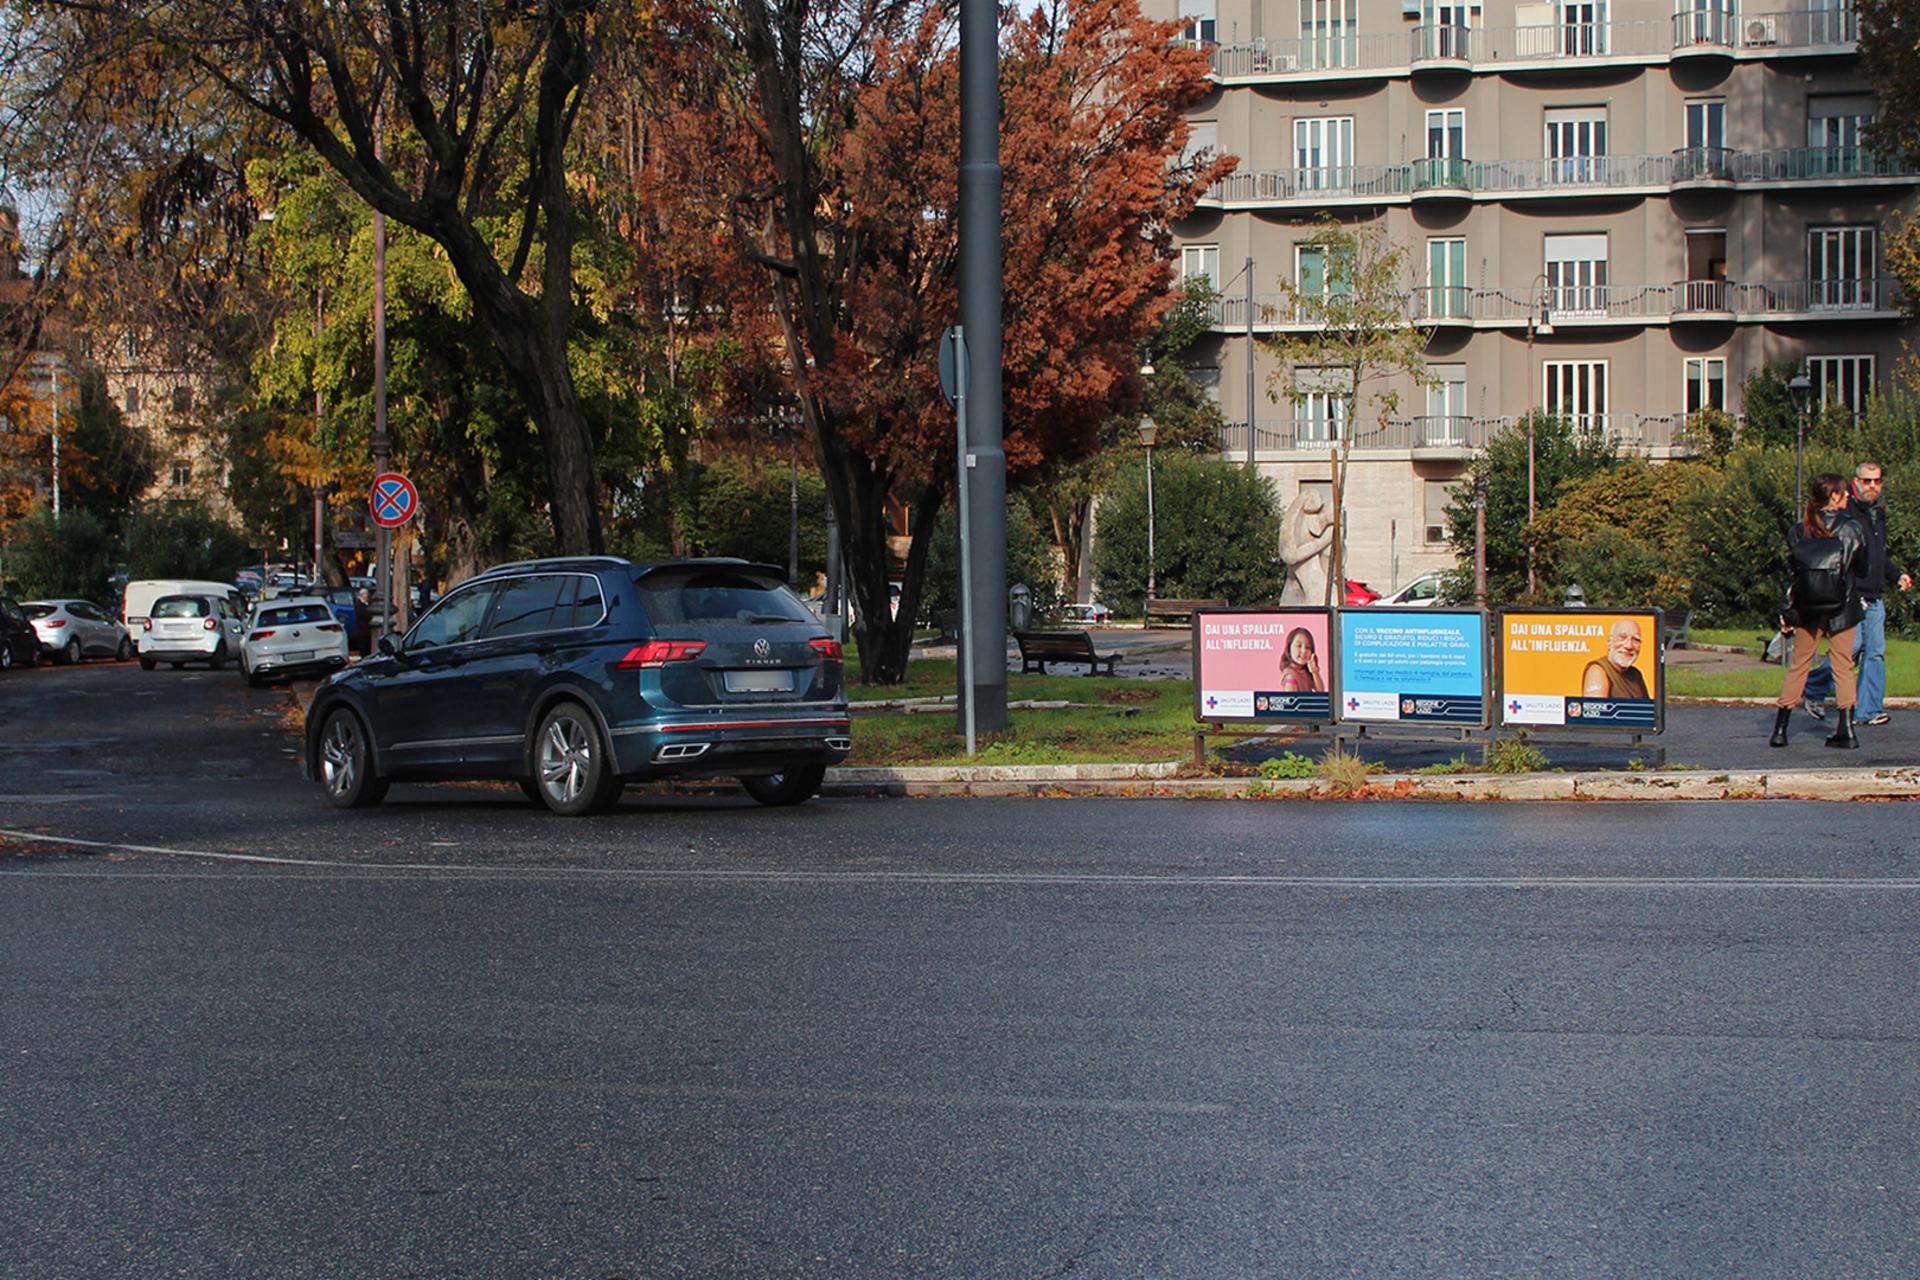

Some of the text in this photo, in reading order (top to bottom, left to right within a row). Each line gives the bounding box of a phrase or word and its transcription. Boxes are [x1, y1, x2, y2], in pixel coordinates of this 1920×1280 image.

[1205, 624, 1285, 635] DAI UNA SPALLATA
[1511, 623, 1604, 636] DAI UNA SPALLATA
[1206, 639, 1273, 650] ALL'INFLUENZA.
[1511, 639, 1591, 652] ALL'INFLUENZA.
[1583, 709, 1600, 718] LAZIO
